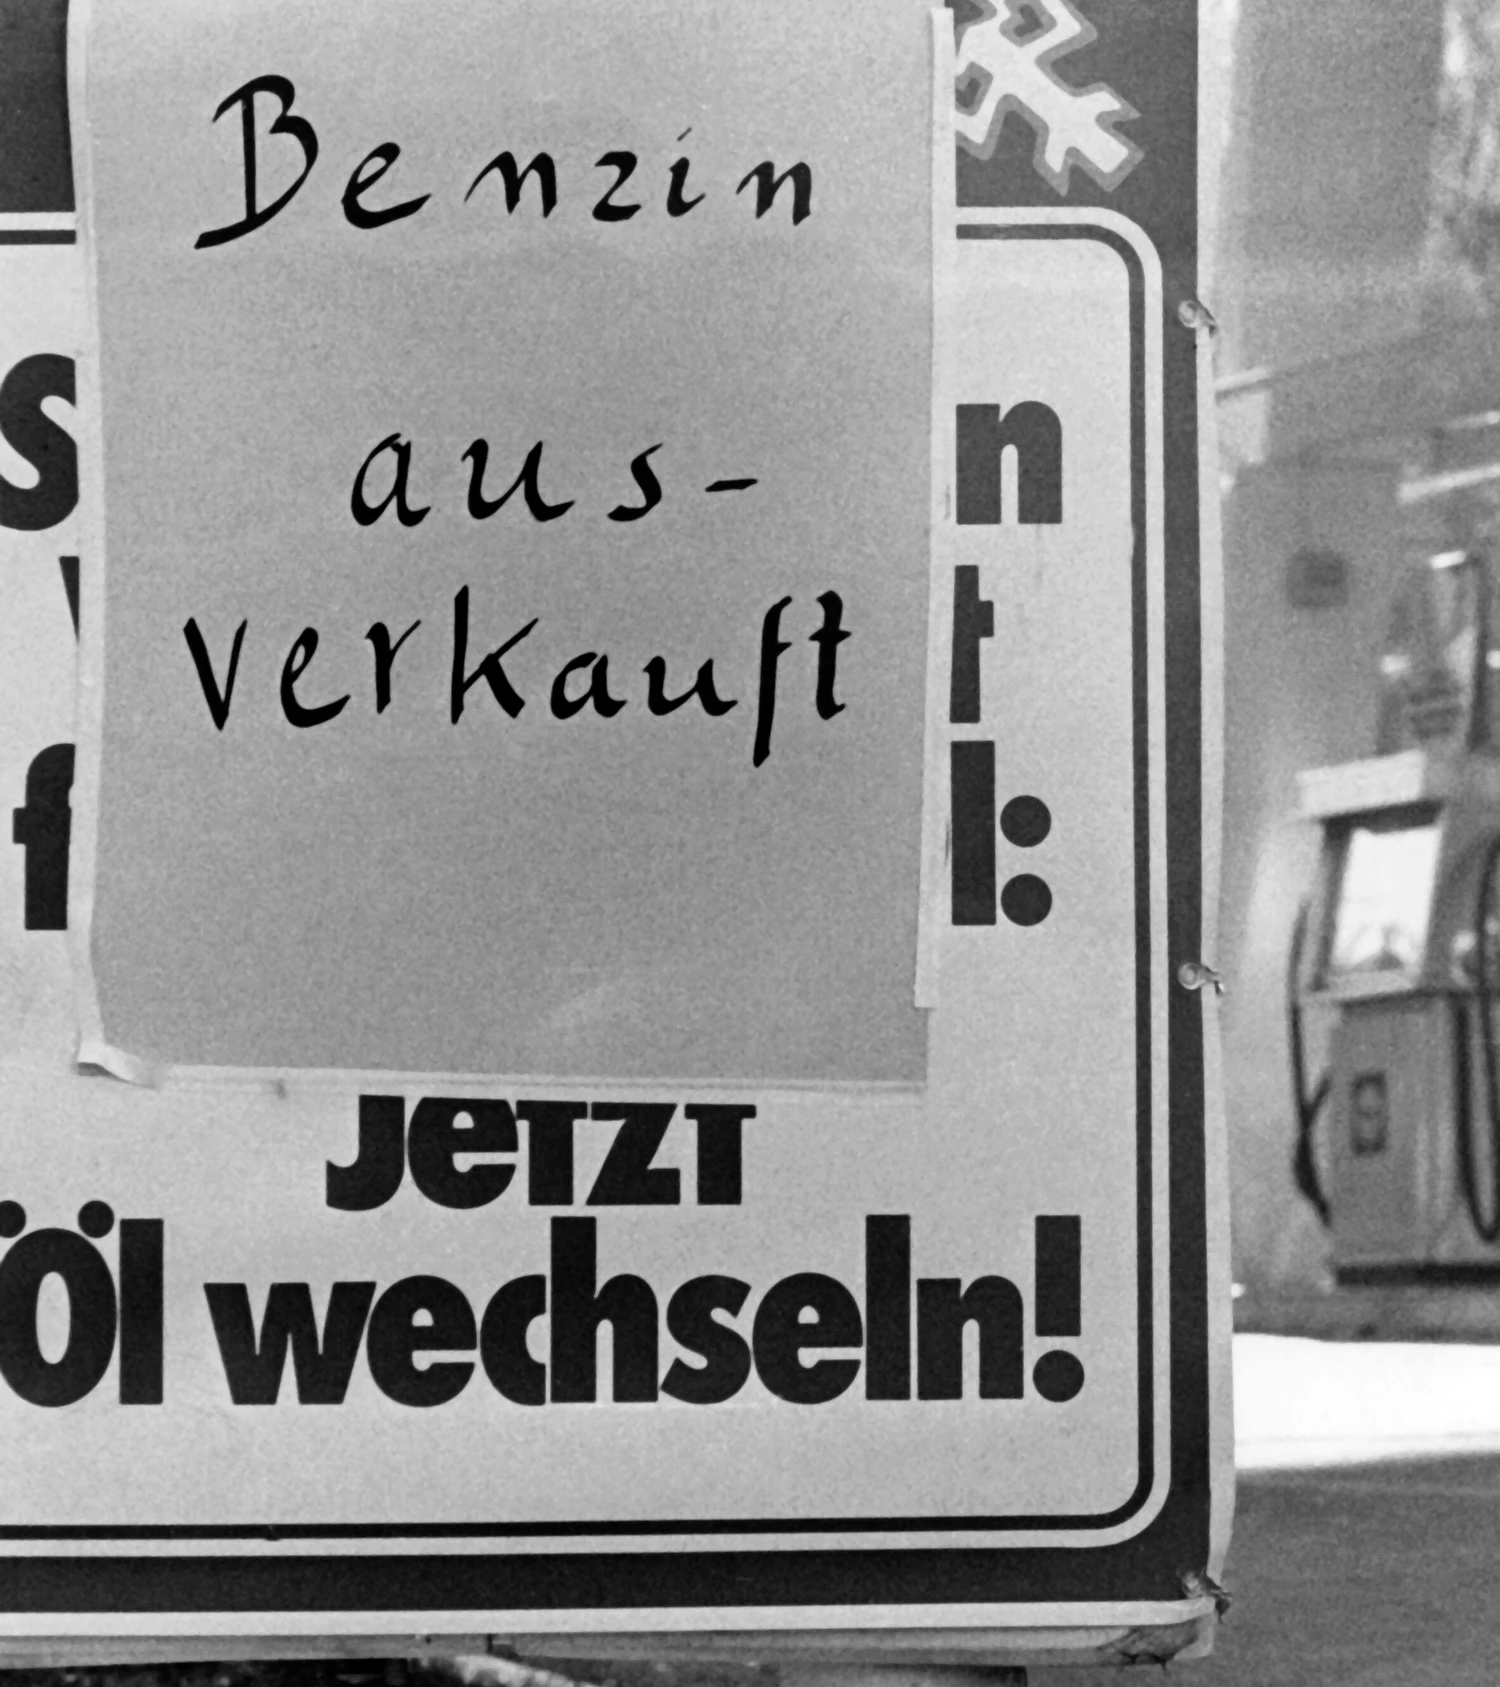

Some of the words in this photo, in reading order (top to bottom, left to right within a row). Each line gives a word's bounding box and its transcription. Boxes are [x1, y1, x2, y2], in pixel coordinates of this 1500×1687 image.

[194, 74, 814, 250] Benzin
[350, 432, 759, 528] aus-
[184, 585, 853, 769] verkauft
[0, 1200, 164, 1408] Öl
[203, 1214, 1085, 1408] wechseln!
